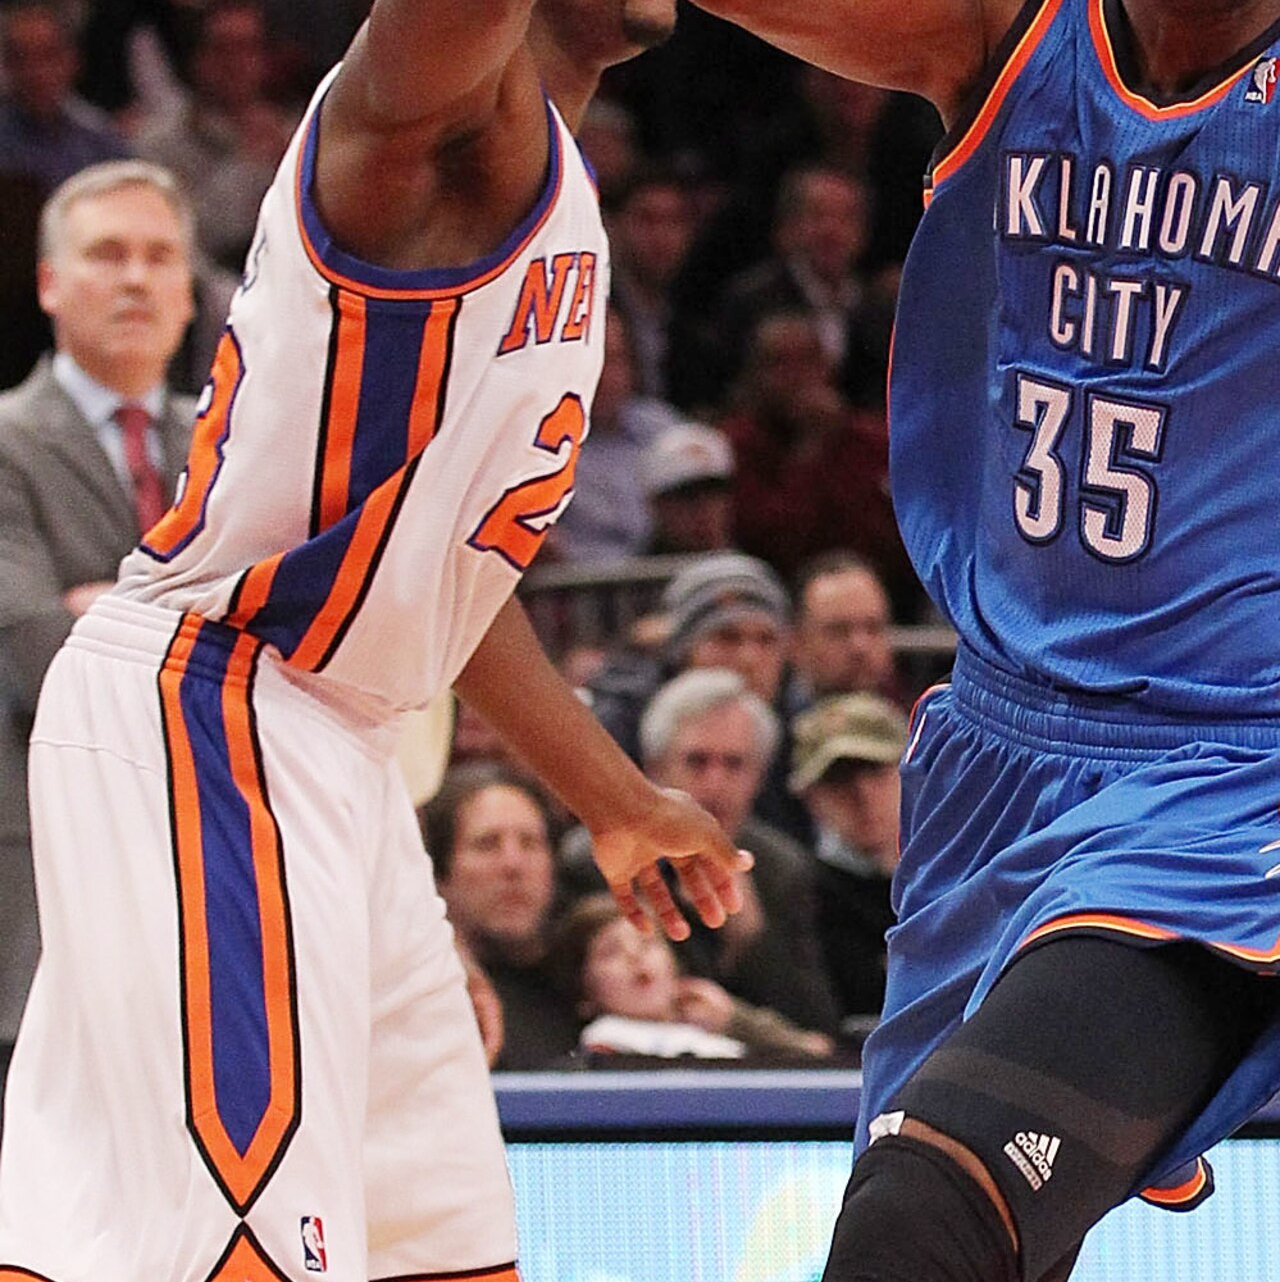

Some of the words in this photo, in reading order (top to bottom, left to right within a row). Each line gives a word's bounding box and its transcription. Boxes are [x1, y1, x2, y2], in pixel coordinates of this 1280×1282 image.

[1050, 263, 1184, 368] CITY
[466, 391, 589, 570] 2
[1012, 373, 1170, 565] 35
[1014, 1131, 1053, 1183] adidas
